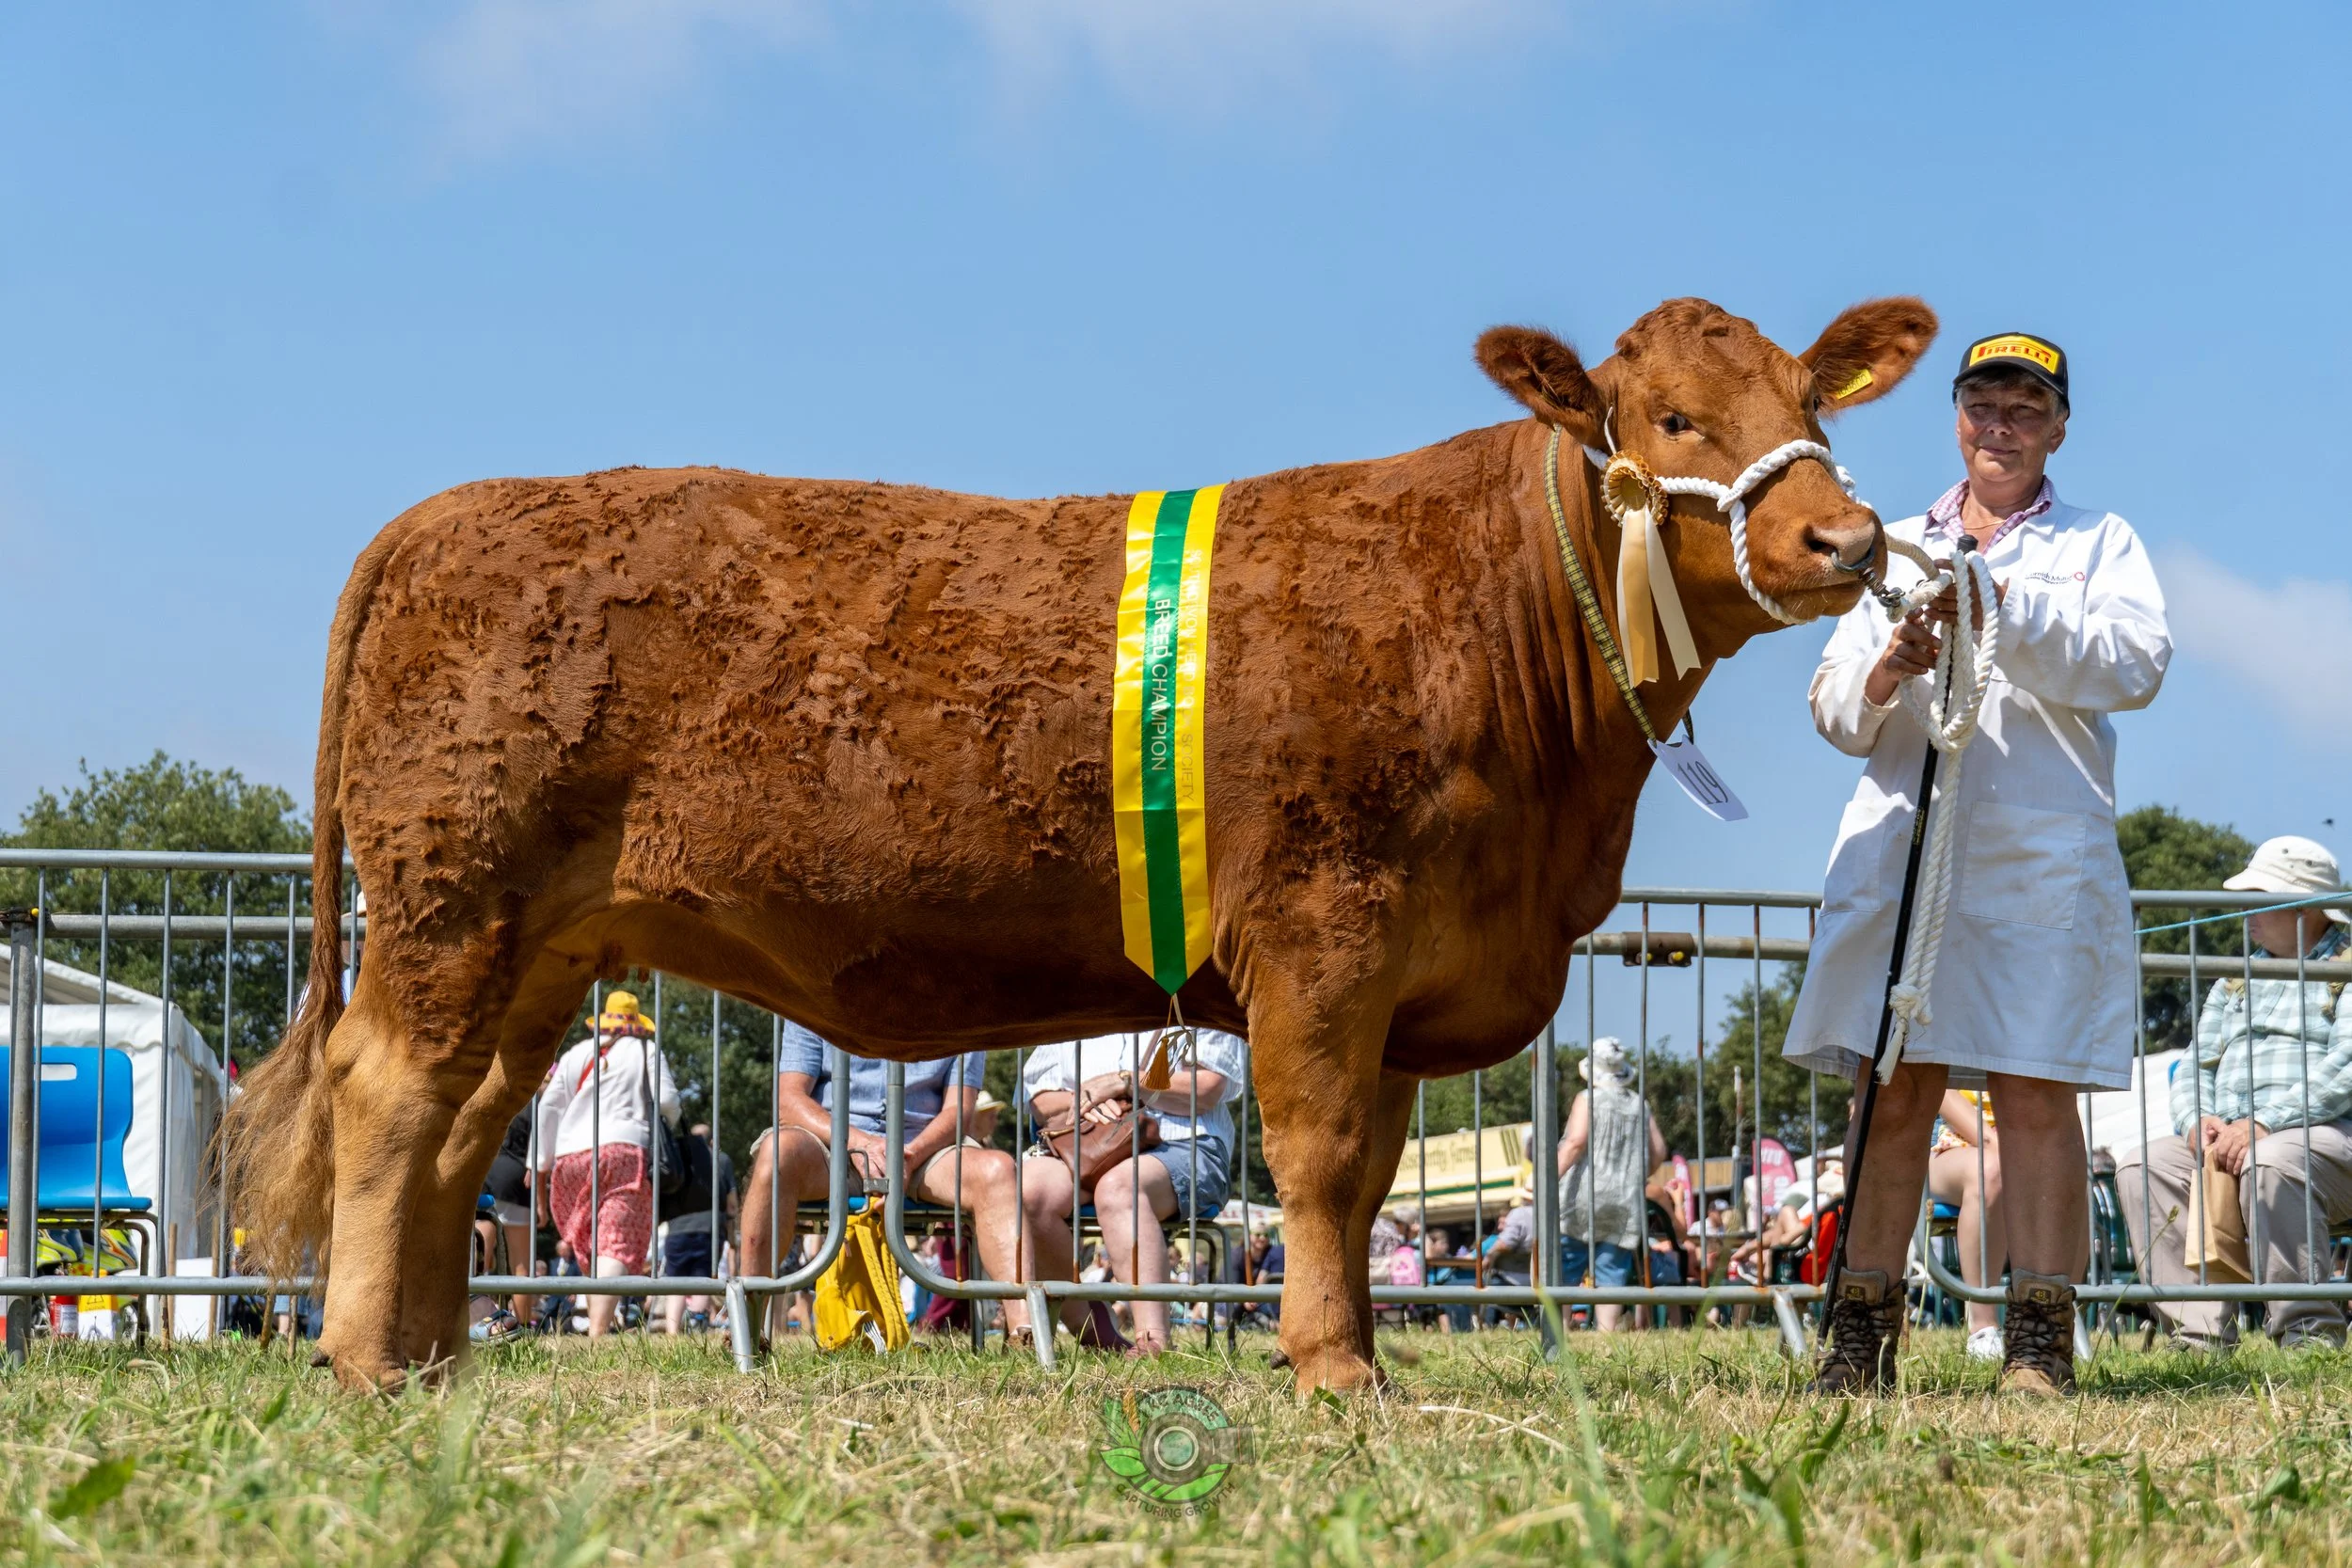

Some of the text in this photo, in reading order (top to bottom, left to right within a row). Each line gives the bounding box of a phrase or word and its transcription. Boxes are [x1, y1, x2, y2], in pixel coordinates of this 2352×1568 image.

[1977, 342, 2052, 364] PIRELLI
[1151, 598, 1170, 770] BREED CHAMPION
[1181, 733, 1194, 802] SOCIETY
[1677, 761, 1727, 805] 119
